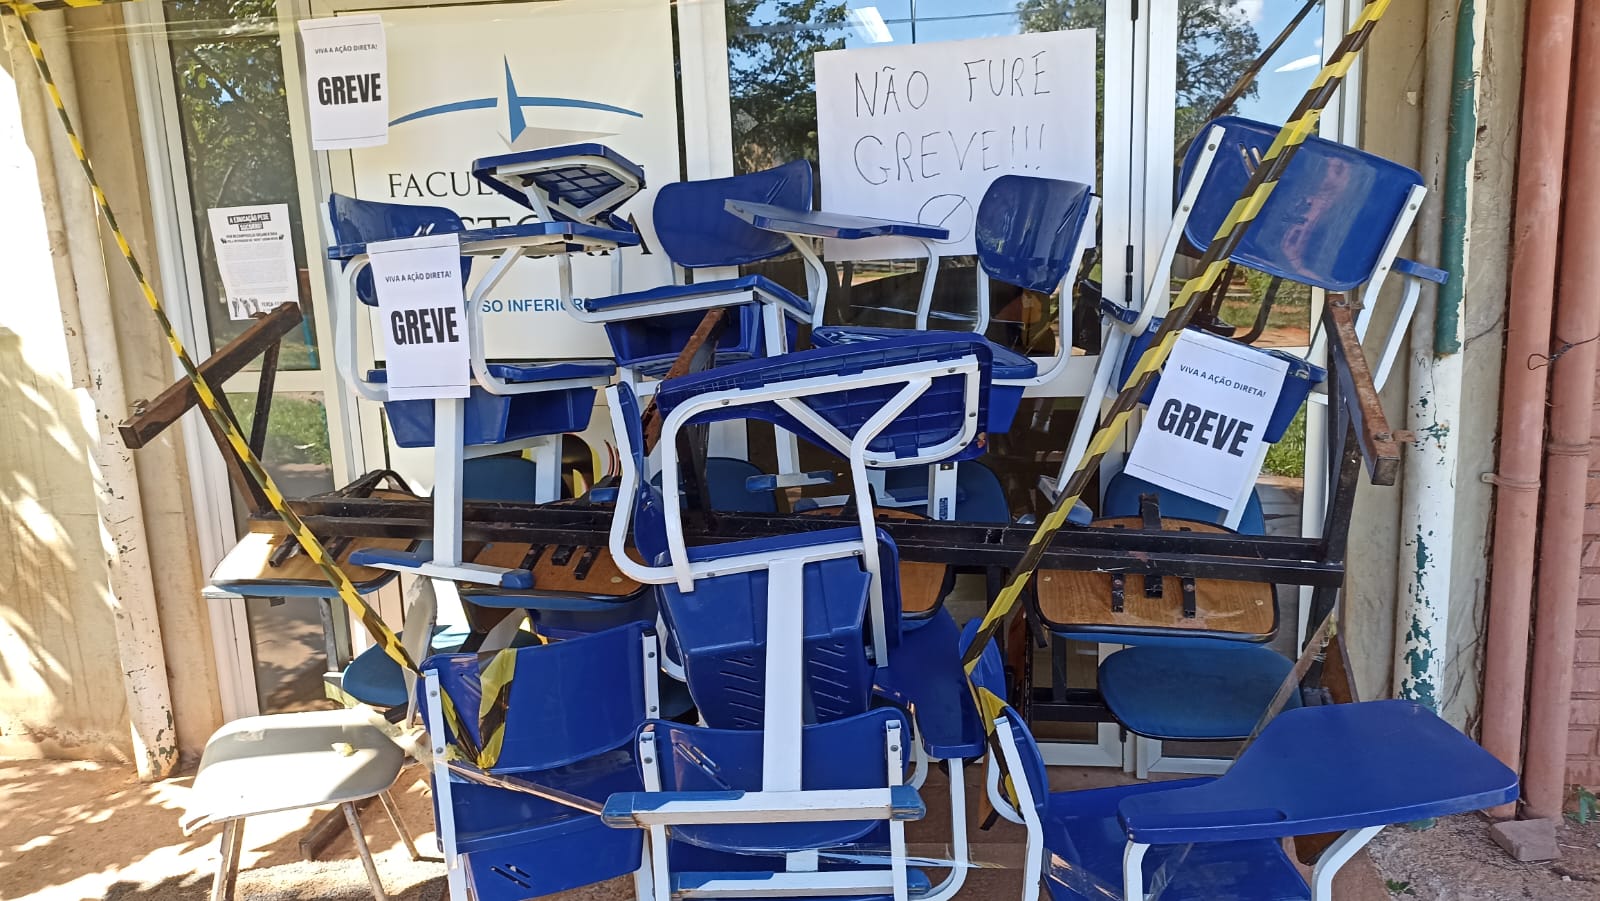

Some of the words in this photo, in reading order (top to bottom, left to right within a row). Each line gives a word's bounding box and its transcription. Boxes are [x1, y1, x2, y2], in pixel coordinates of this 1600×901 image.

[334, 44, 352, 54] AÇÃO
[353, 43, 378, 51] DIRETA!
[317, 73, 382, 106] GREVE
[855, 66, 929, 117] NÃO
[964, 50, 1050, 102] FURE
[853, 123, 1046, 185] GREVE!!!
[407, 271, 424, 282] AÇÃO
[425, 271, 452, 279] DIRETA!
[482, 300, 503, 313] SO
[390, 306, 460, 346] GREVE
[1180, 364, 1199, 377] VIVA
[1200, 371, 1207, 379] A
[1207, 374, 1232, 387] AÇÃO
[1233, 382, 1267, 398] DIRETA!
[1157, 398, 1254, 458] GREVE
